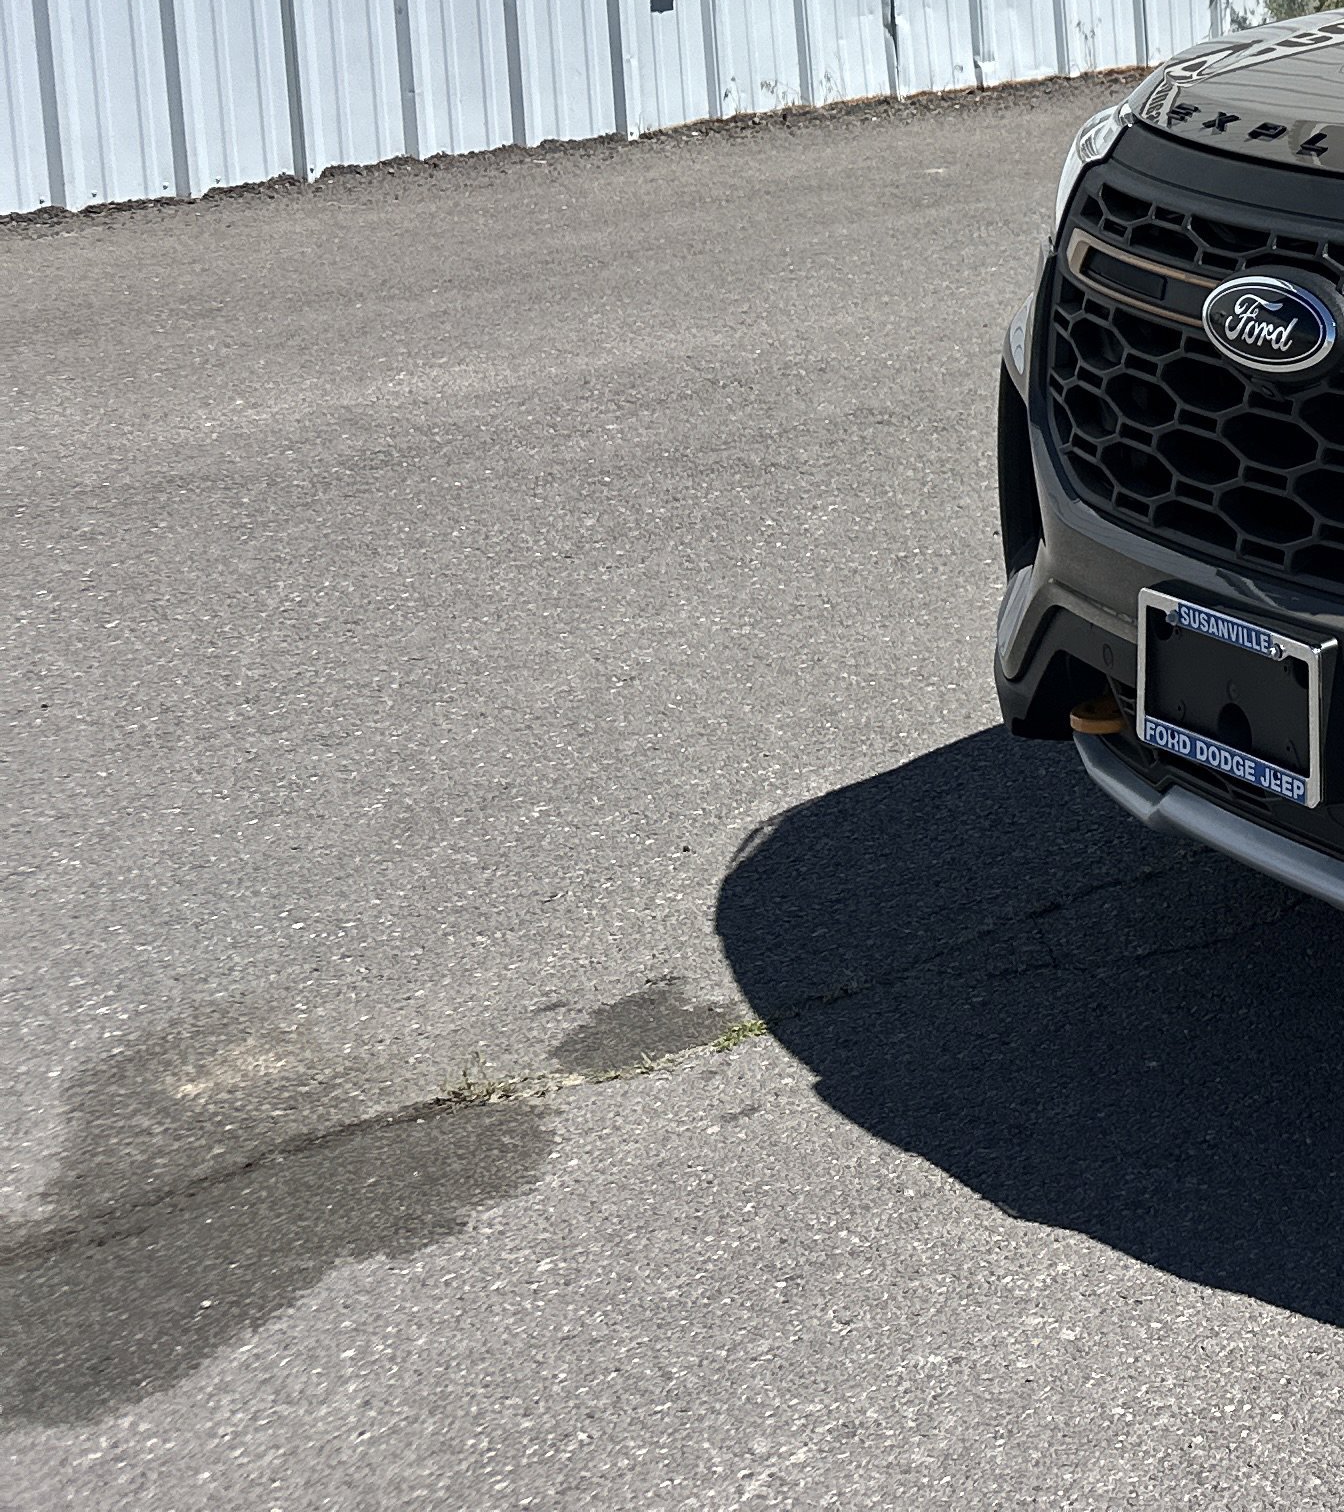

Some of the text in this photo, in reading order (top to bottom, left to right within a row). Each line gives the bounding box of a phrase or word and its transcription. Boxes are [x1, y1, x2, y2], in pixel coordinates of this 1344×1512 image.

[1224, 292, 1296, 353] Ford
[1180, 606, 1270, 654] SUSANVILLE
[1146, 721, 1305, 800] FORD DODGE JEEP
